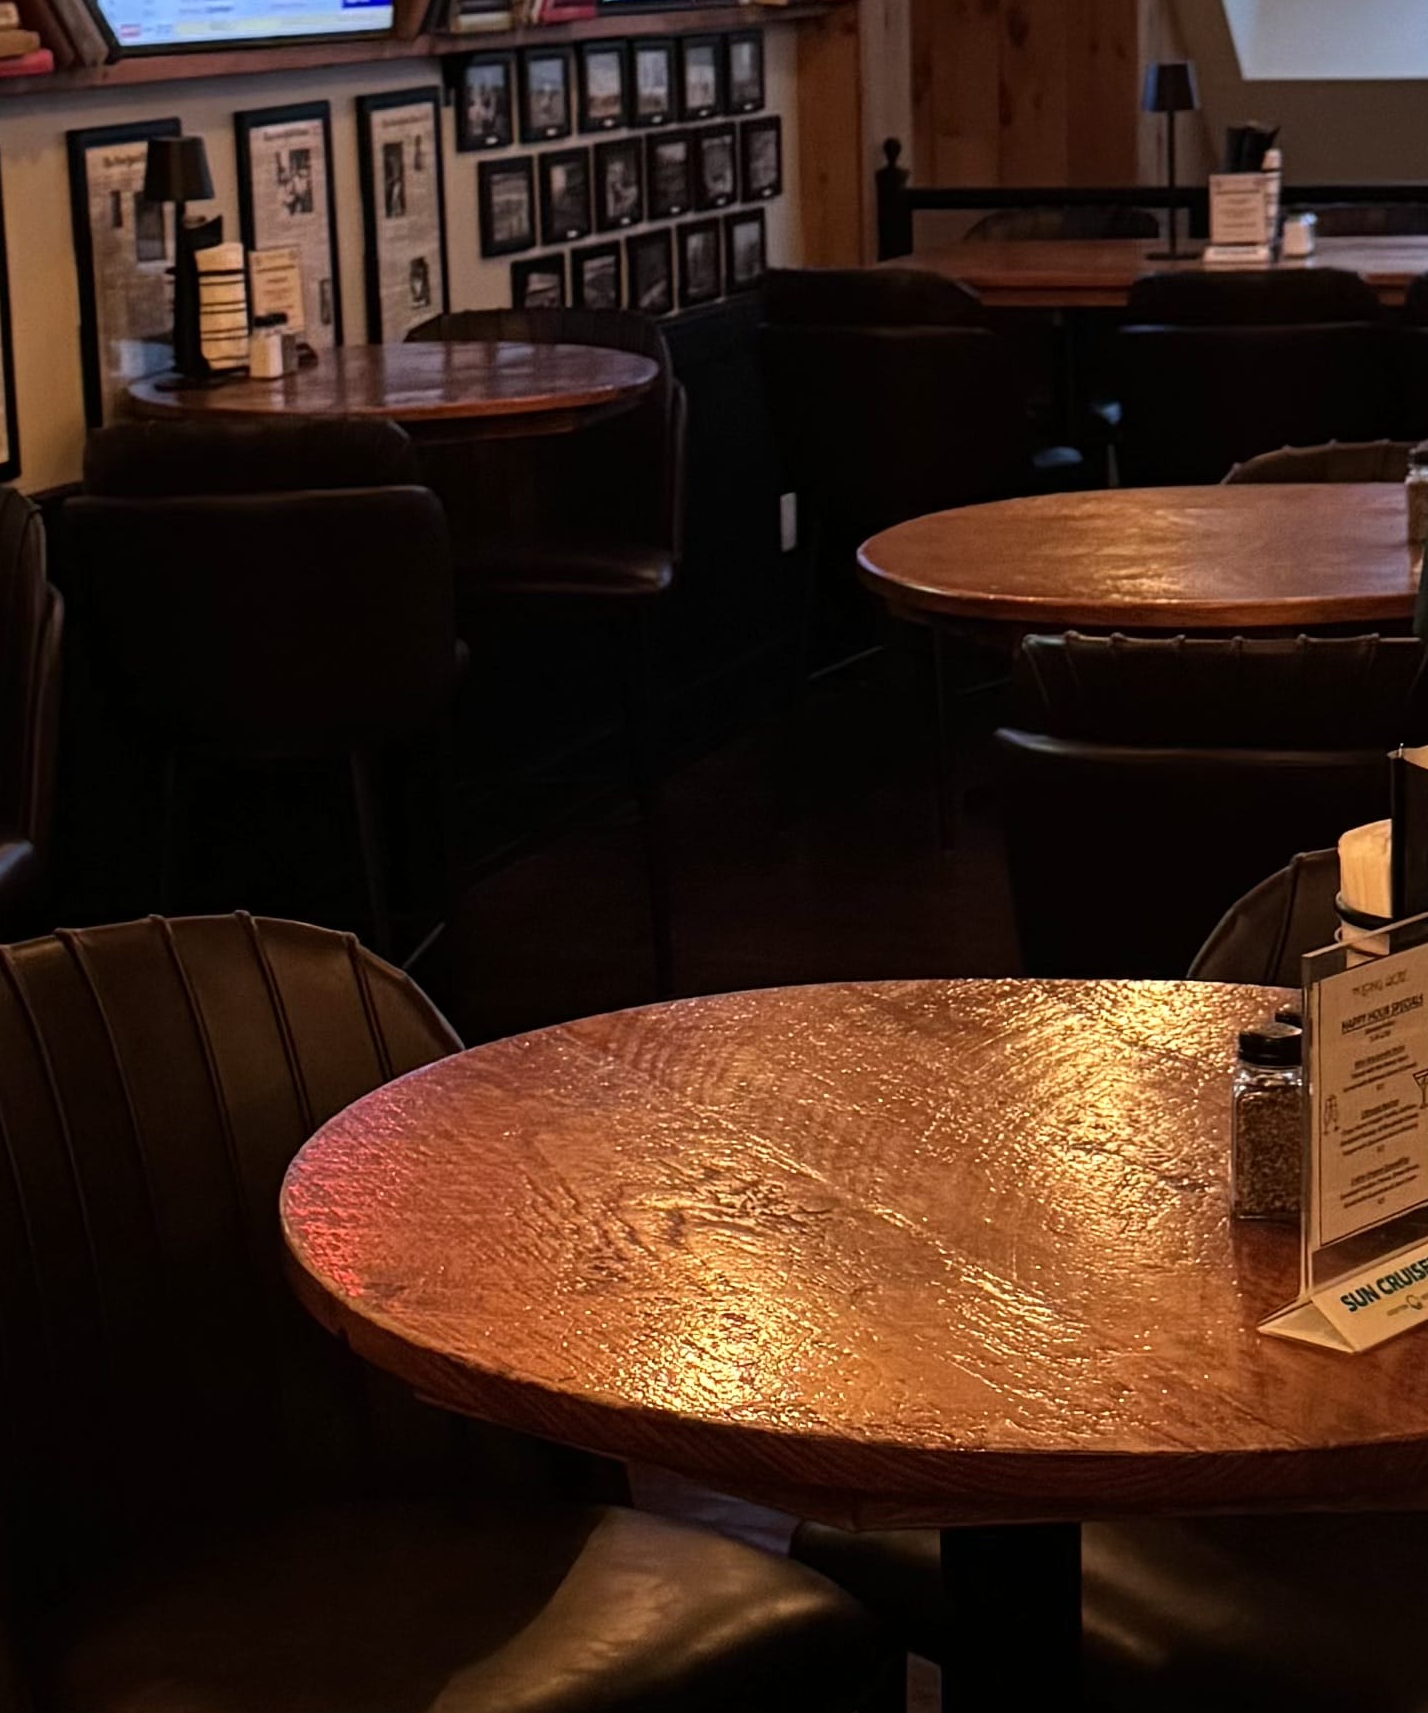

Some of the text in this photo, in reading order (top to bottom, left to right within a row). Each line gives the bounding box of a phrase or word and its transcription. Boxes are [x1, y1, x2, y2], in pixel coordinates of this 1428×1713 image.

[1341, 1013, 1367, 1032] HAPPY
[1367, 1005, 1390, 1024] HOUR
[1340, 1284, 1381, 1313] SUN
